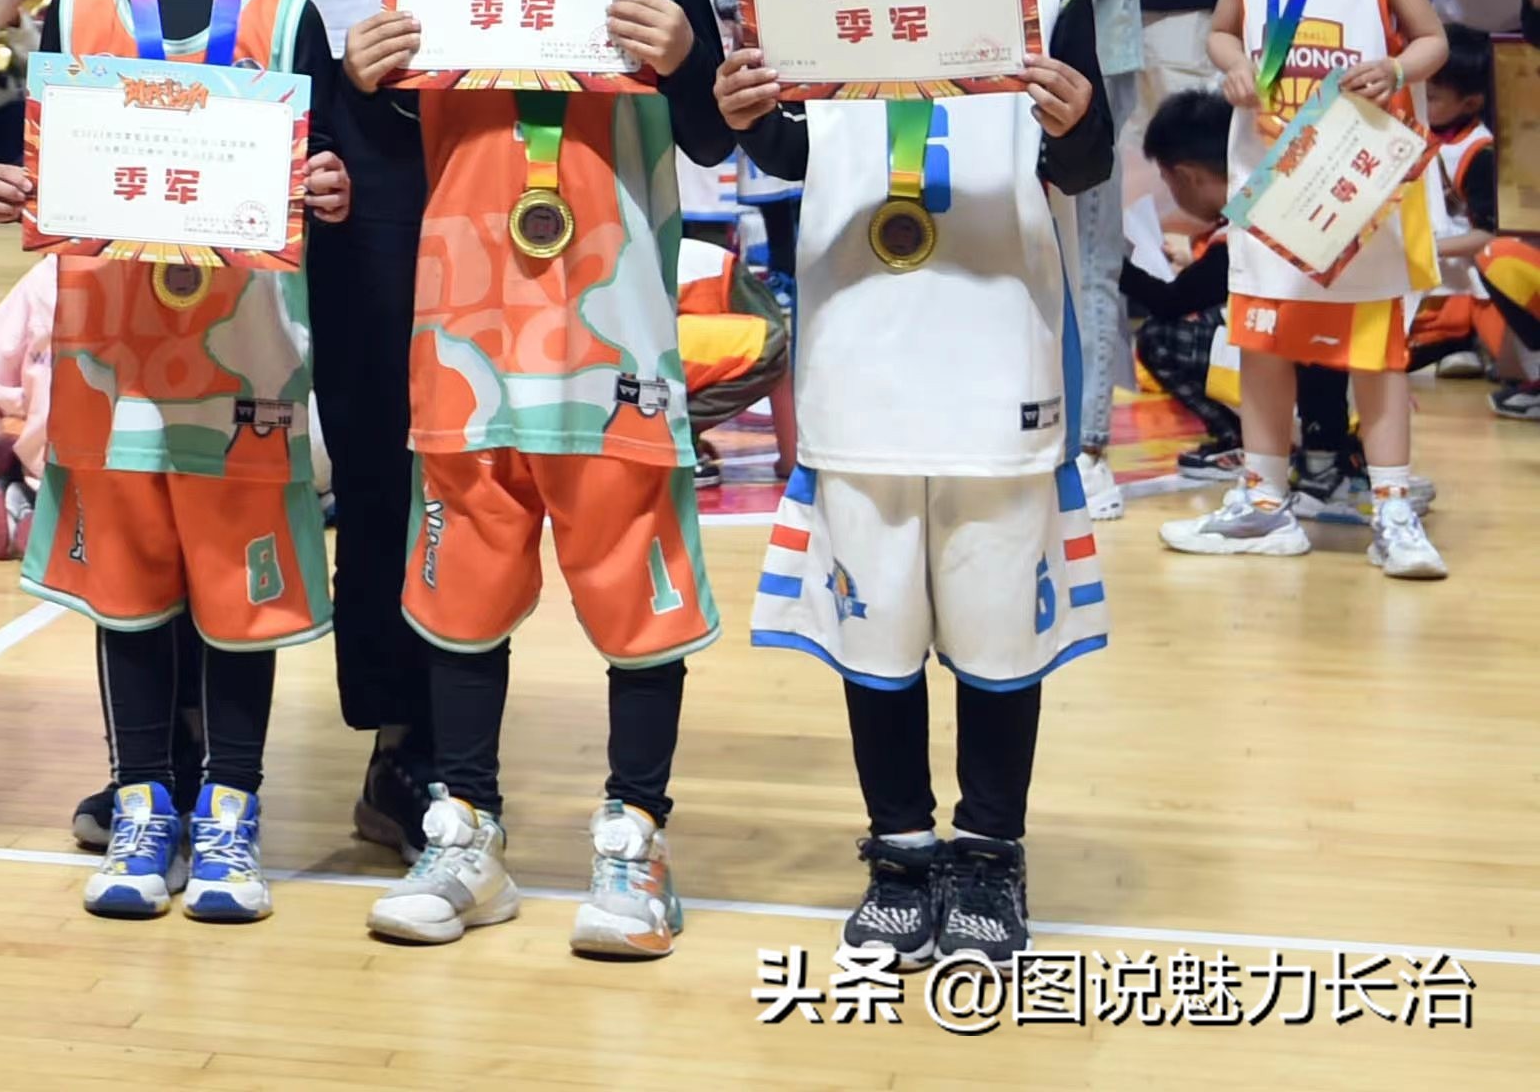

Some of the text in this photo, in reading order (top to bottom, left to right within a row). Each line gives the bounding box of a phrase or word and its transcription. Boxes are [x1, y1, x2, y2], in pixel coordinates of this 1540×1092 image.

[835, 5, 930, 44] 季军
[114, 166, 201, 205] 季军
[1309, 147, 1381, 232] 二等奖
[245, 533, 285, 605] 8
[647, 537, 684, 616] 1
[1034, 552, 1057, 635] 6
